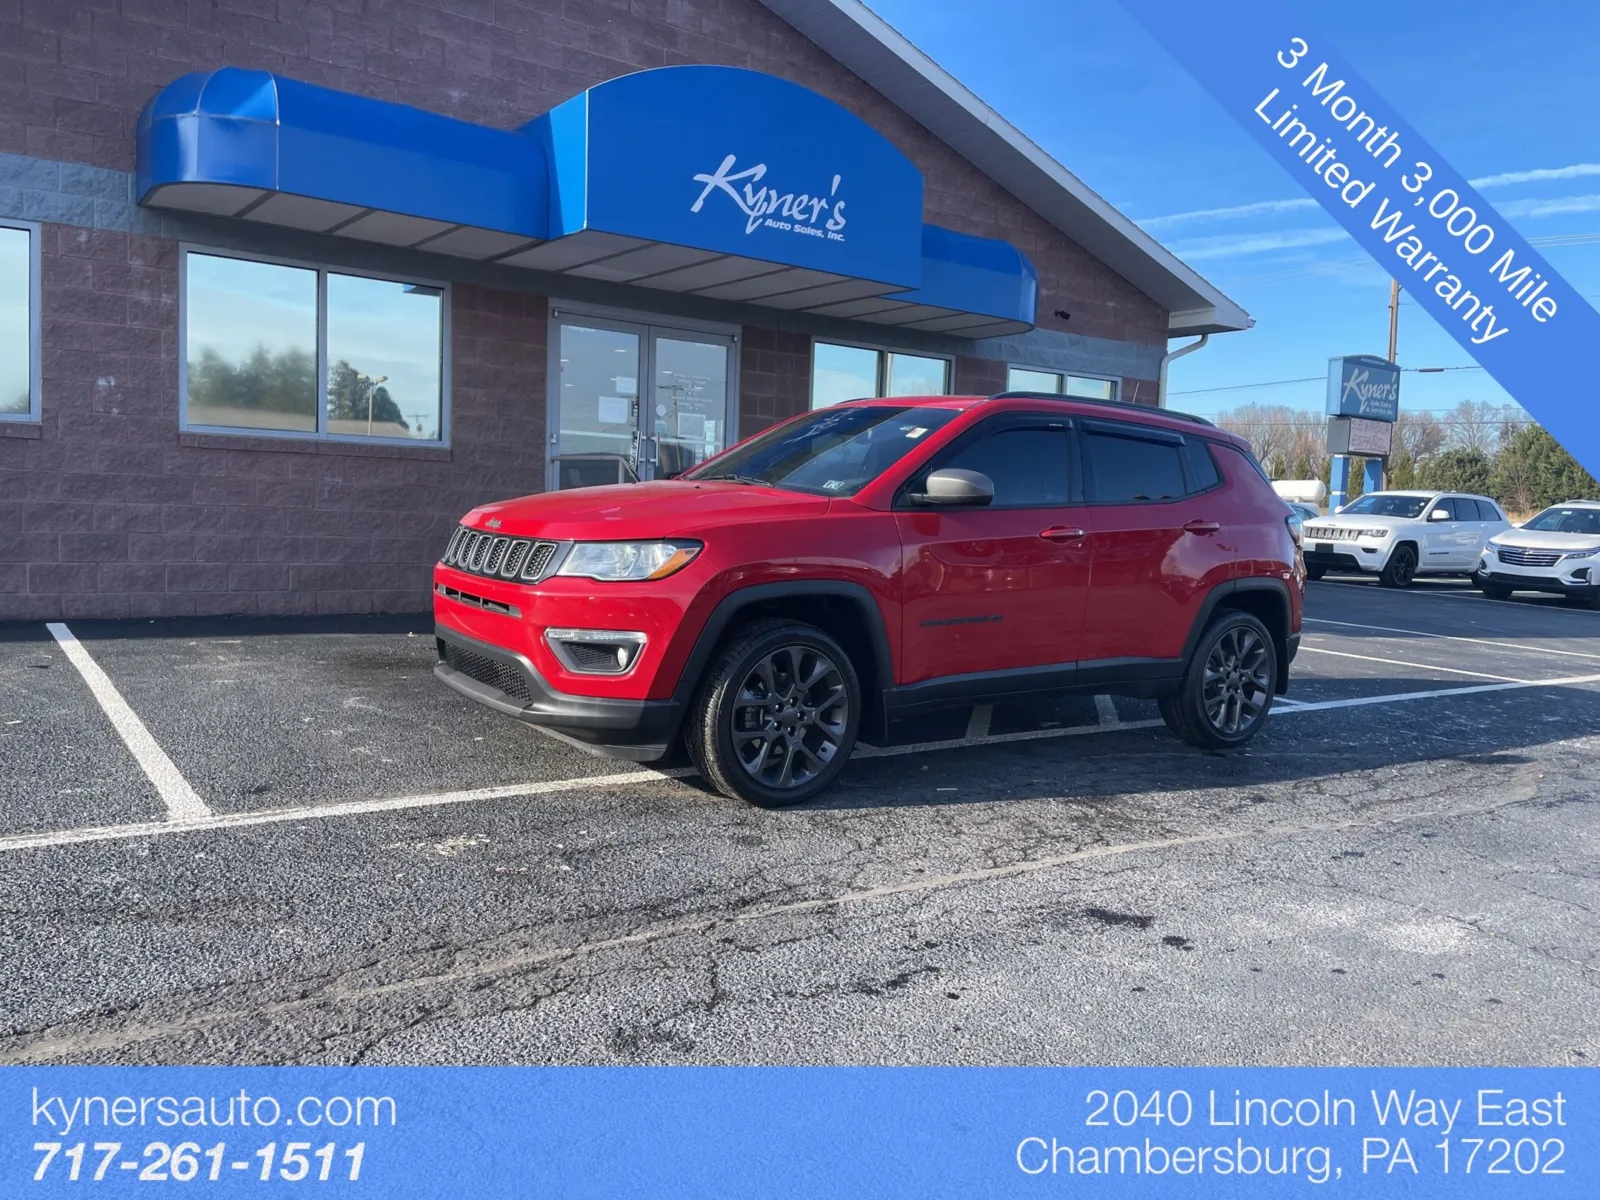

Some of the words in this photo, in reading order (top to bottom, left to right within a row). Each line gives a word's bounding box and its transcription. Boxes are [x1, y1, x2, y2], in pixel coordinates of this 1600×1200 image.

[690, 153, 847, 235] Kyner's
[764, 218, 792, 231] Auto
[793, 224, 825, 239] Sales,
[827, 230, 845, 242] Inc.
[1342, 367, 1397, 414] Kyner's
